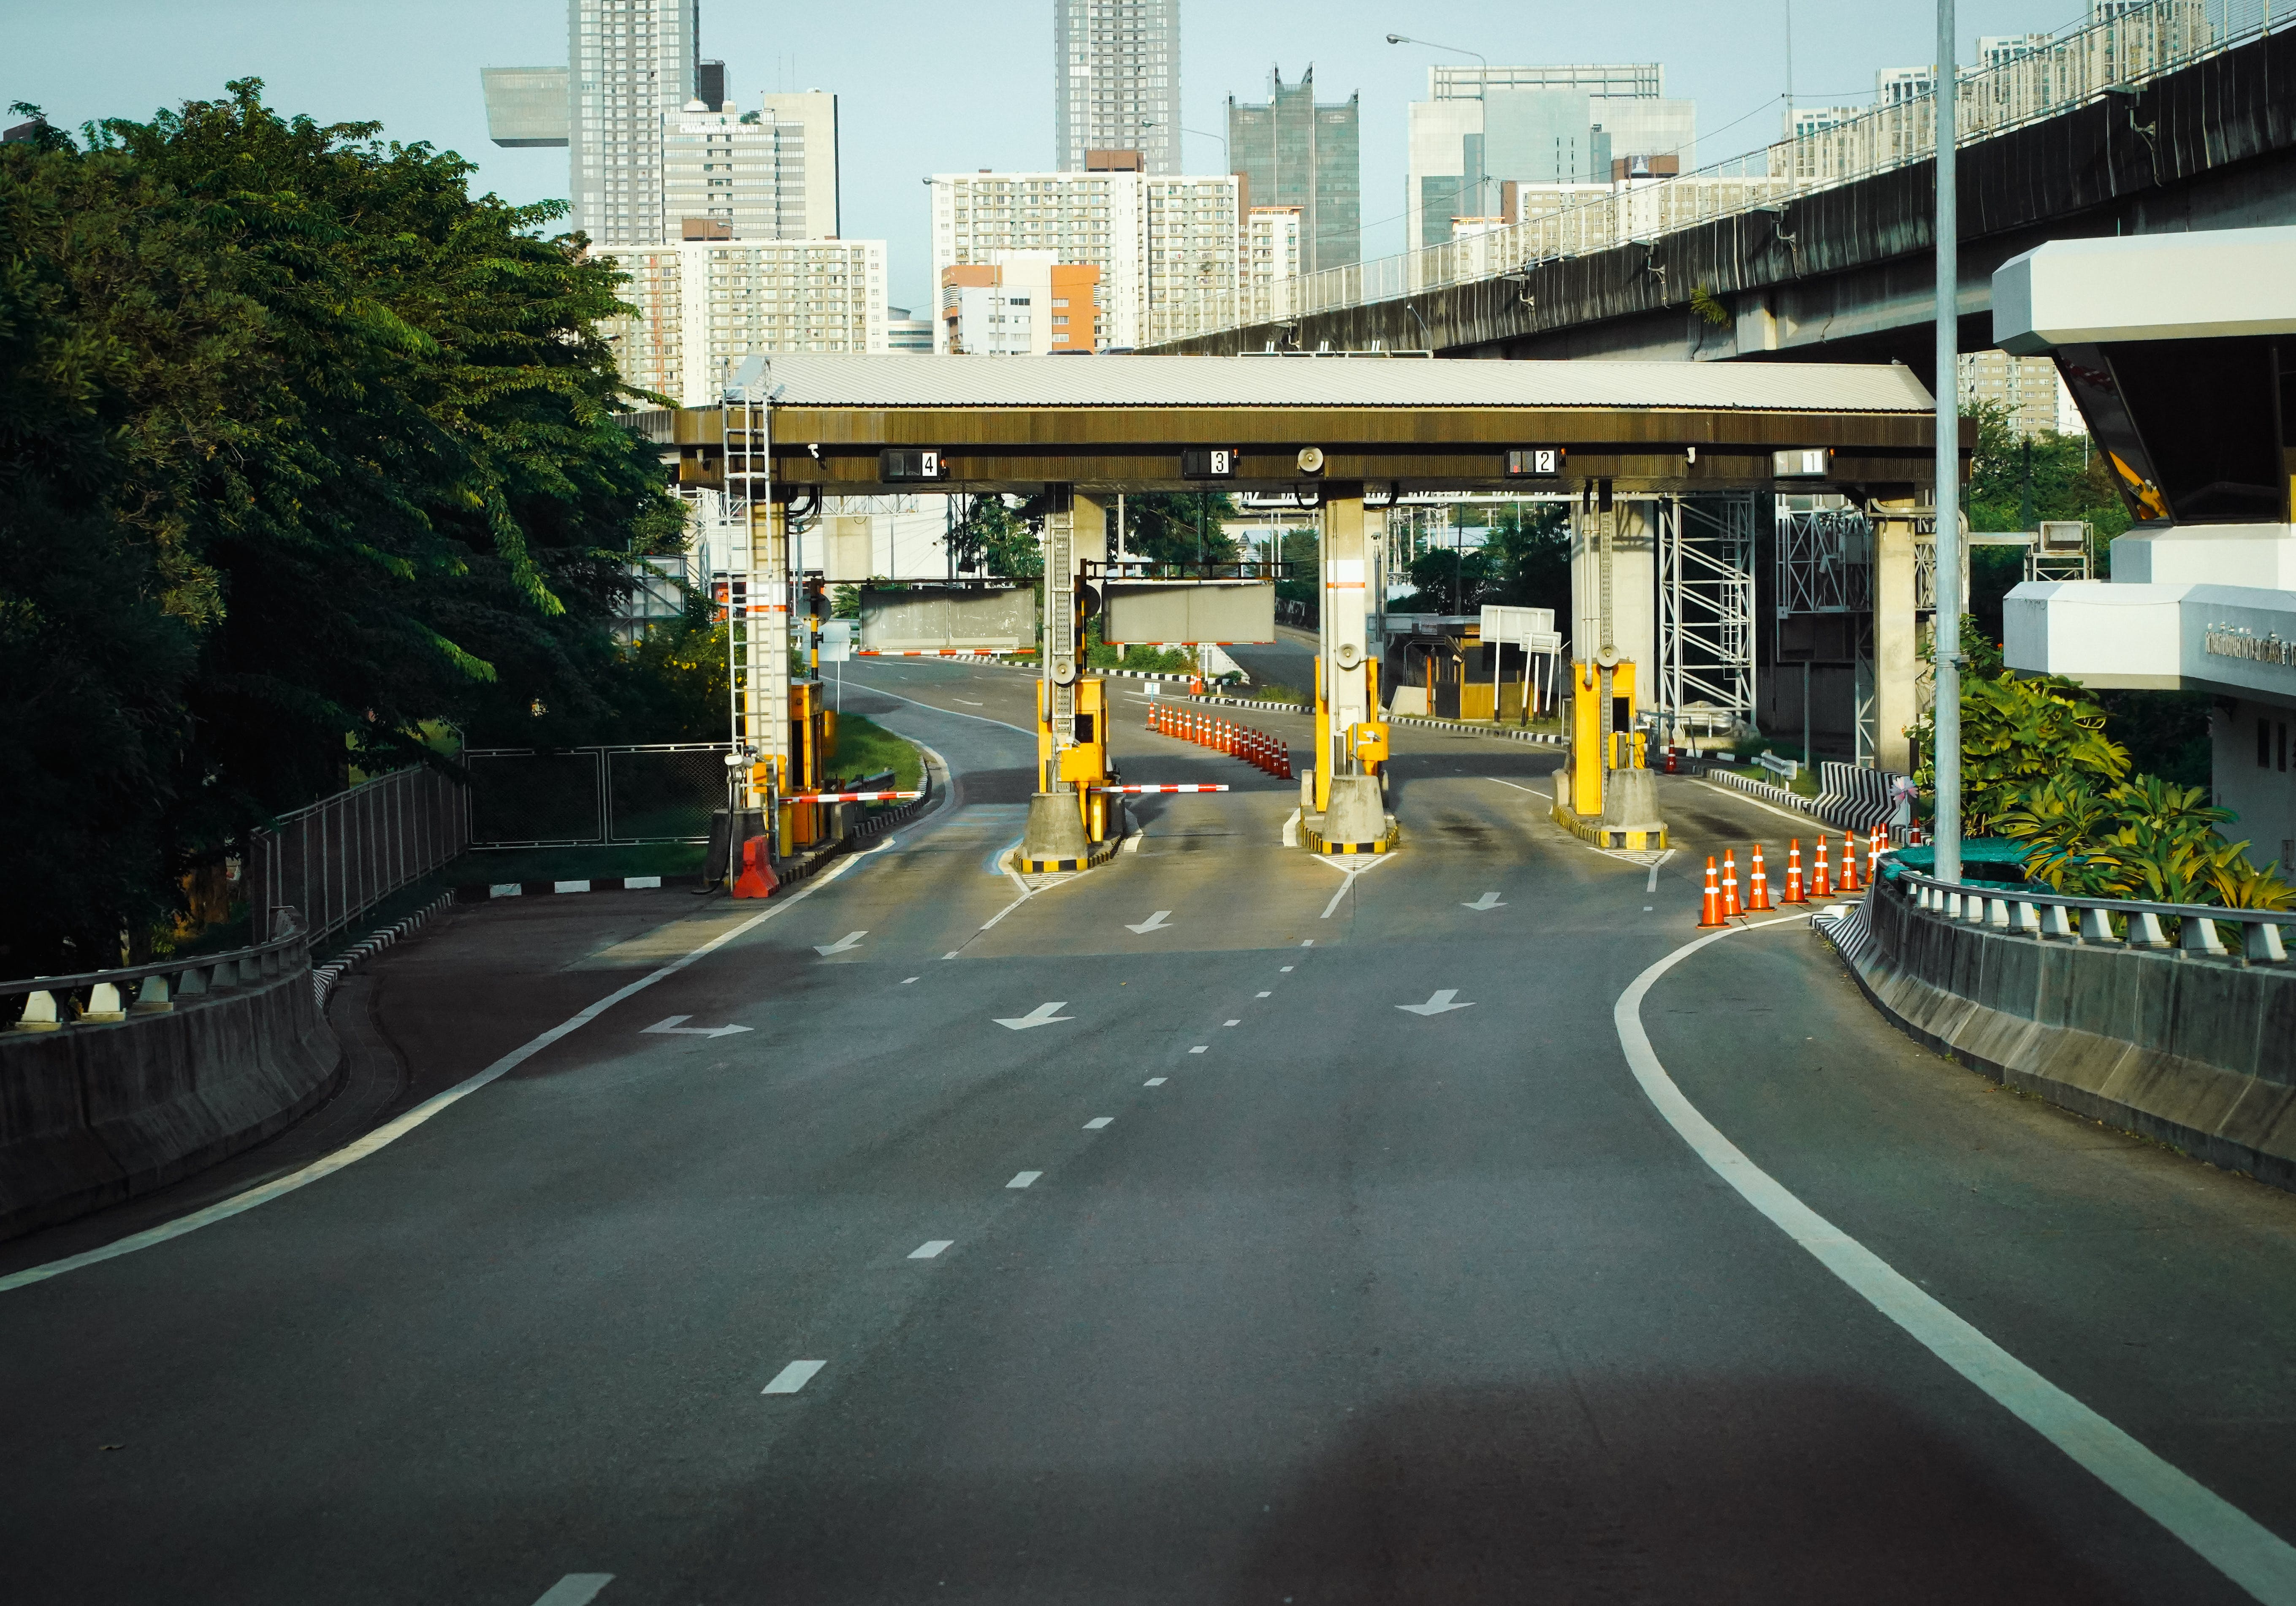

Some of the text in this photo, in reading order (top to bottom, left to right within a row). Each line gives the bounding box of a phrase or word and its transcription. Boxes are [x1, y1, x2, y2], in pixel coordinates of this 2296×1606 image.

[680, 125, 720, 133] CHAMNAN
[925, 456, 933, 472] 4
[1216, 453, 1223, 472] 3
[1541, 452, 1549, 470] 2
[1811, 453, 1815, 471] 1
